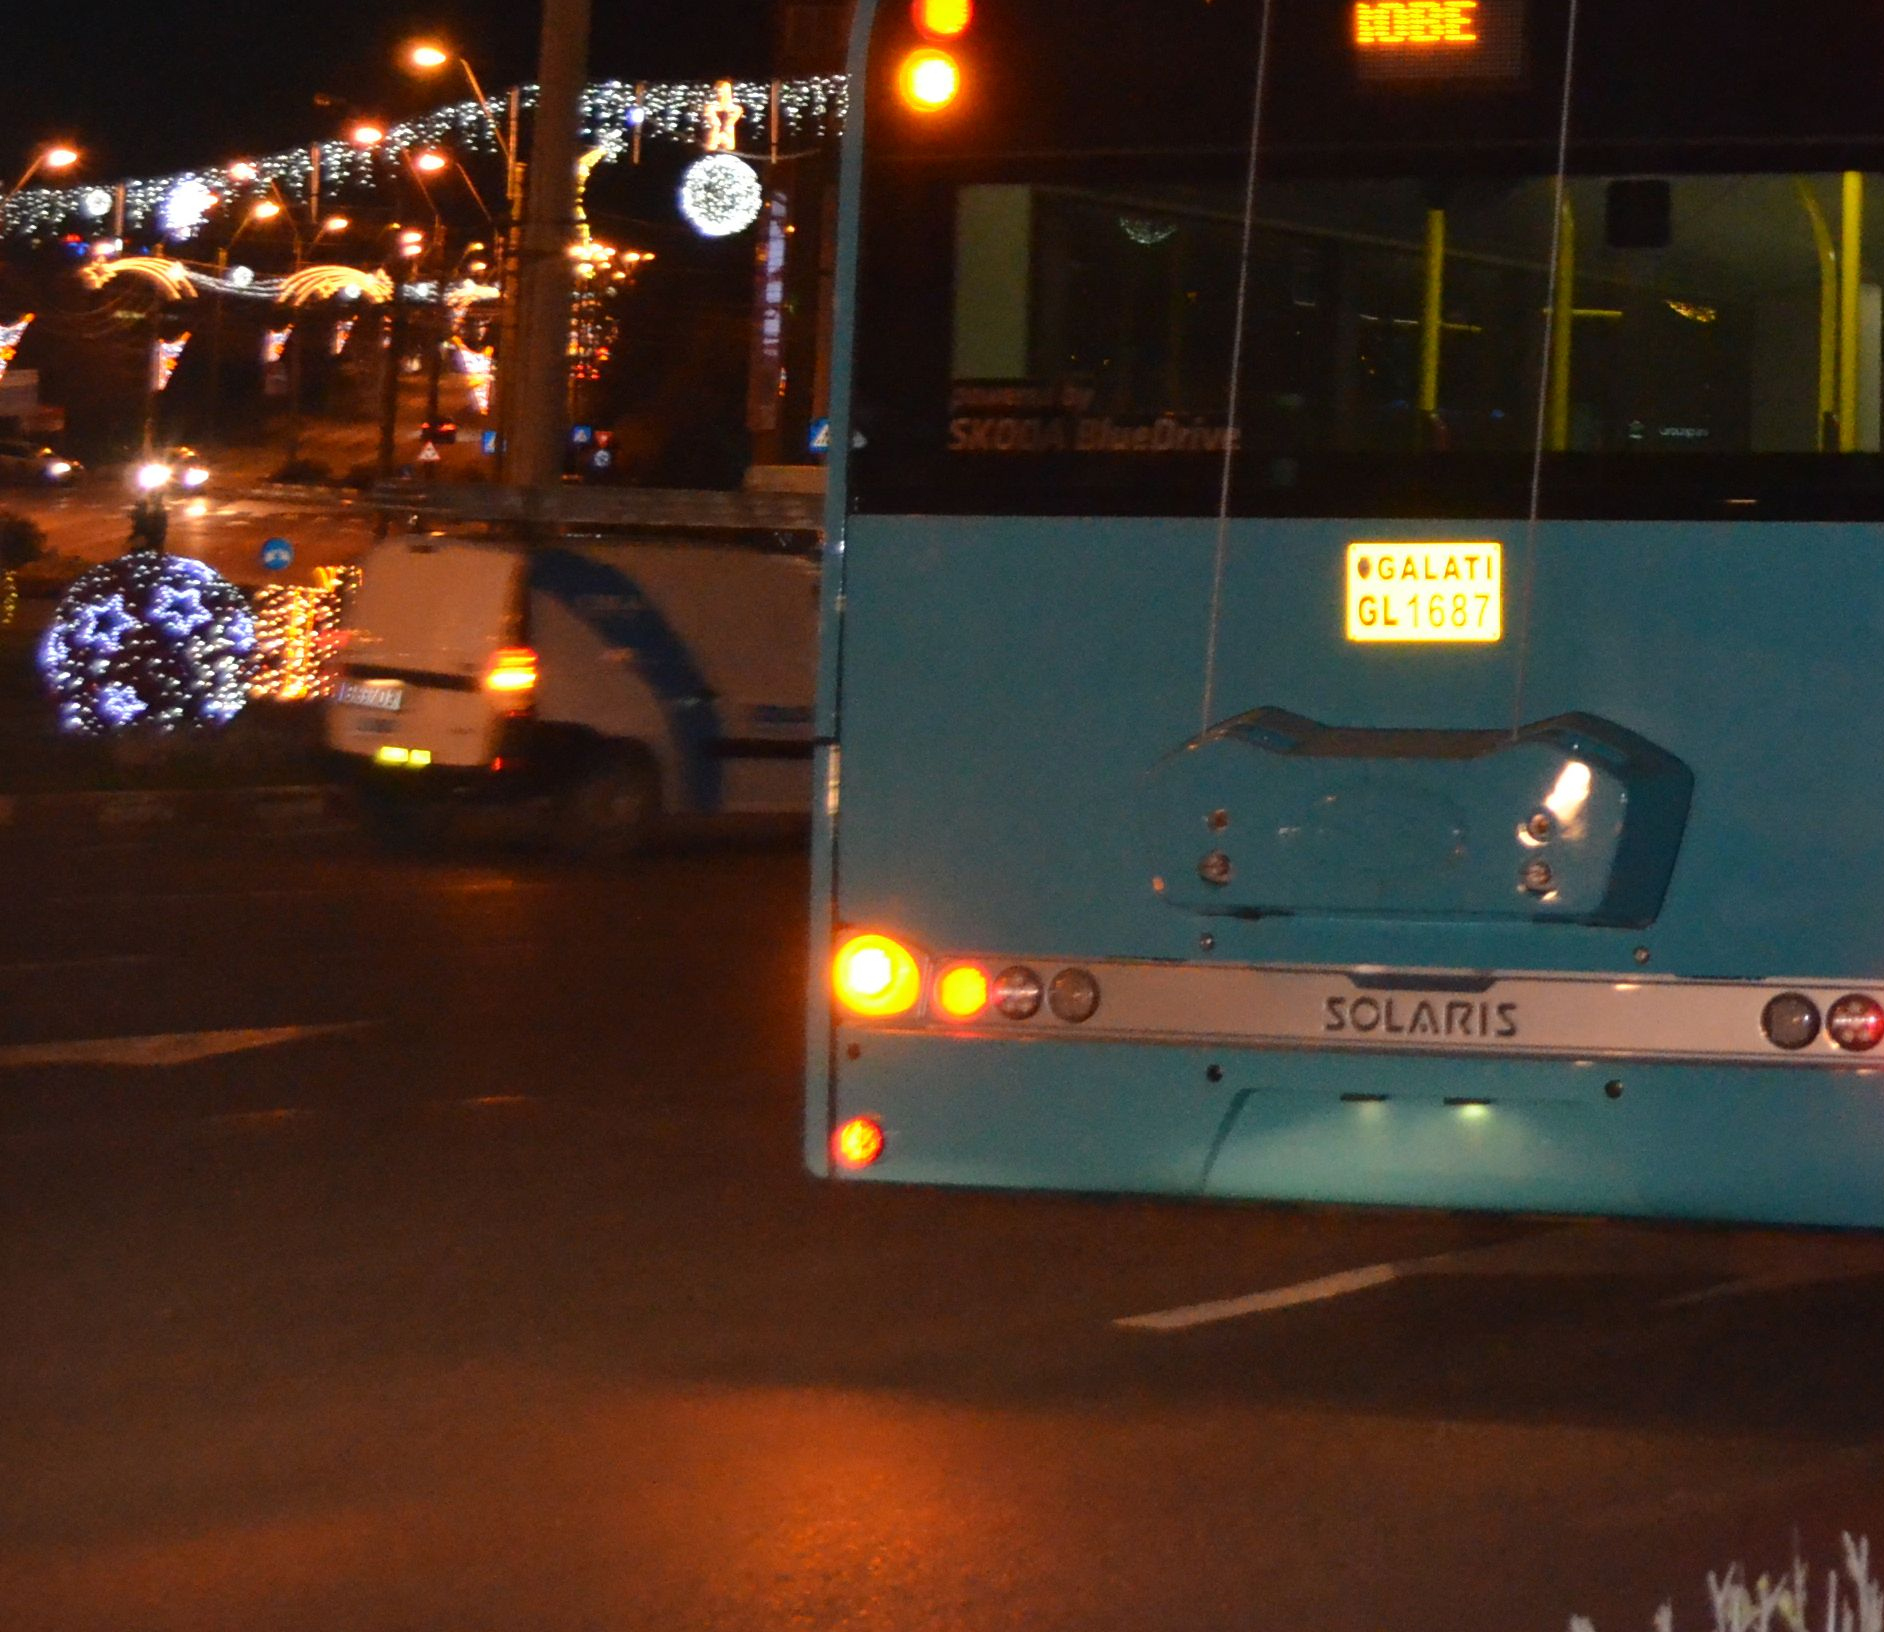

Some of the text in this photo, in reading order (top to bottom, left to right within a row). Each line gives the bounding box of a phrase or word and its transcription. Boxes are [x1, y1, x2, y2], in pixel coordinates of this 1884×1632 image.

[1074, 415, 1243, 451] BlueDrive
[1377, 555, 1493, 581] GALATI
[1324, 995, 1517, 1037] SOLARIS
